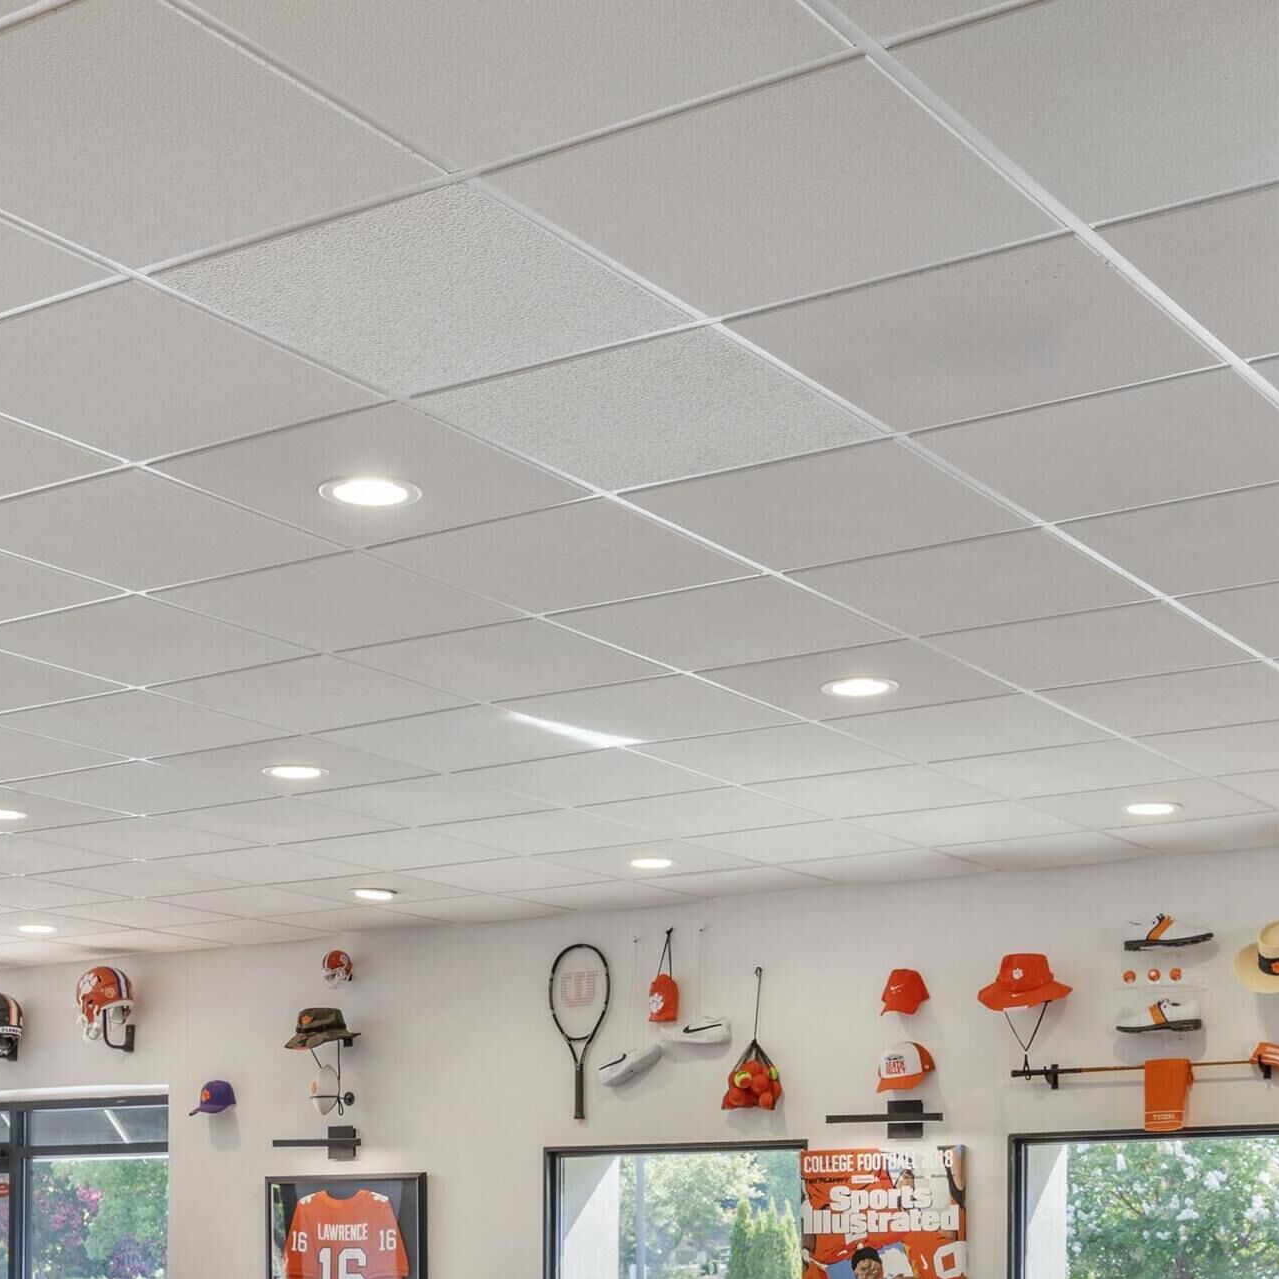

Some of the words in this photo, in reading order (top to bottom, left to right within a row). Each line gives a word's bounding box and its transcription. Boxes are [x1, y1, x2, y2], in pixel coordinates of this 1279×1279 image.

[803, 1154, 854, 1173] COLLEGE
[857, 1150, 917, 1172] FOOTBALL
[829, 1186, 933, 1212] Sports
[801, 1199, 960, 1234] Illustrated
[291, 1231, 308, 1252] 16
[317, 1222, 369, 1241] LAWRENCE
[379, 1229, 397, 1251] 16
